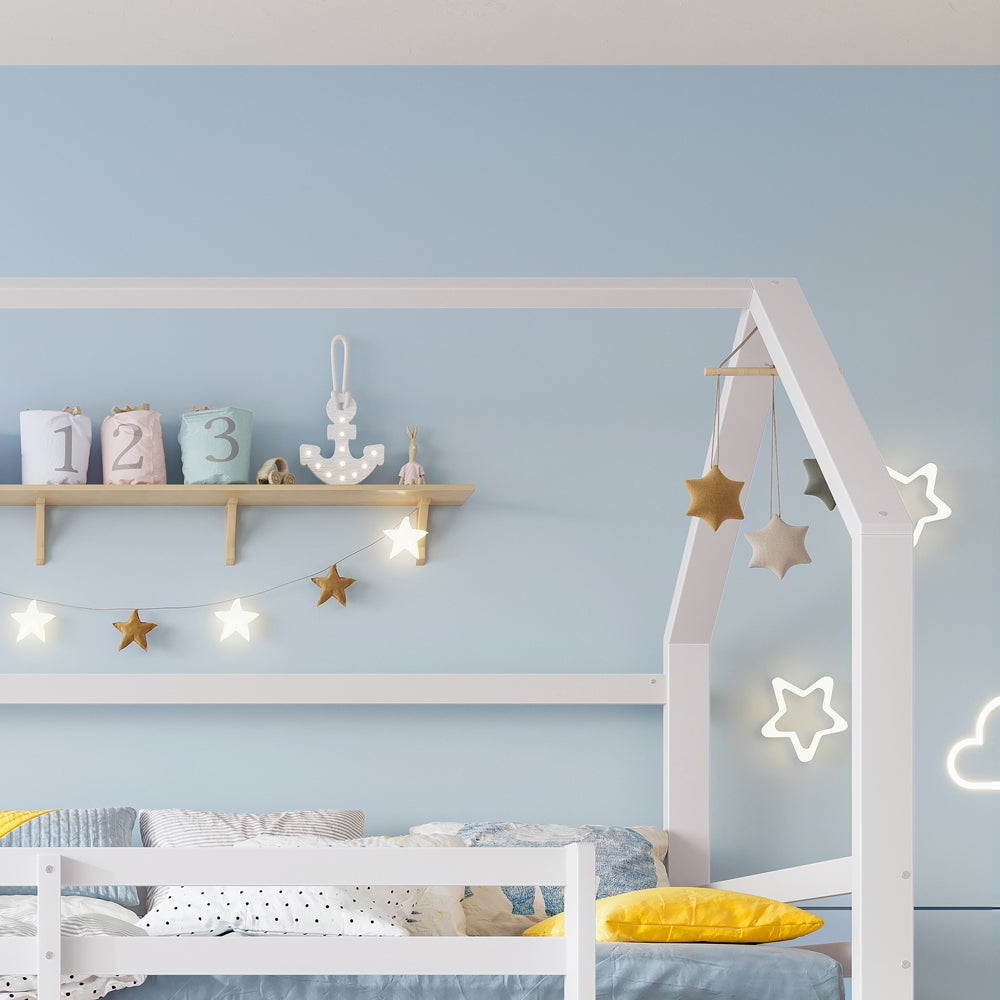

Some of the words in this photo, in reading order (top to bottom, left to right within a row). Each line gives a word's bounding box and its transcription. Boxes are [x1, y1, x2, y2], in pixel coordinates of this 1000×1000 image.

[53, 425, 79, 474] 1
[111, 423, 144, 472] 2
[204, 416, 240, 463] 3
